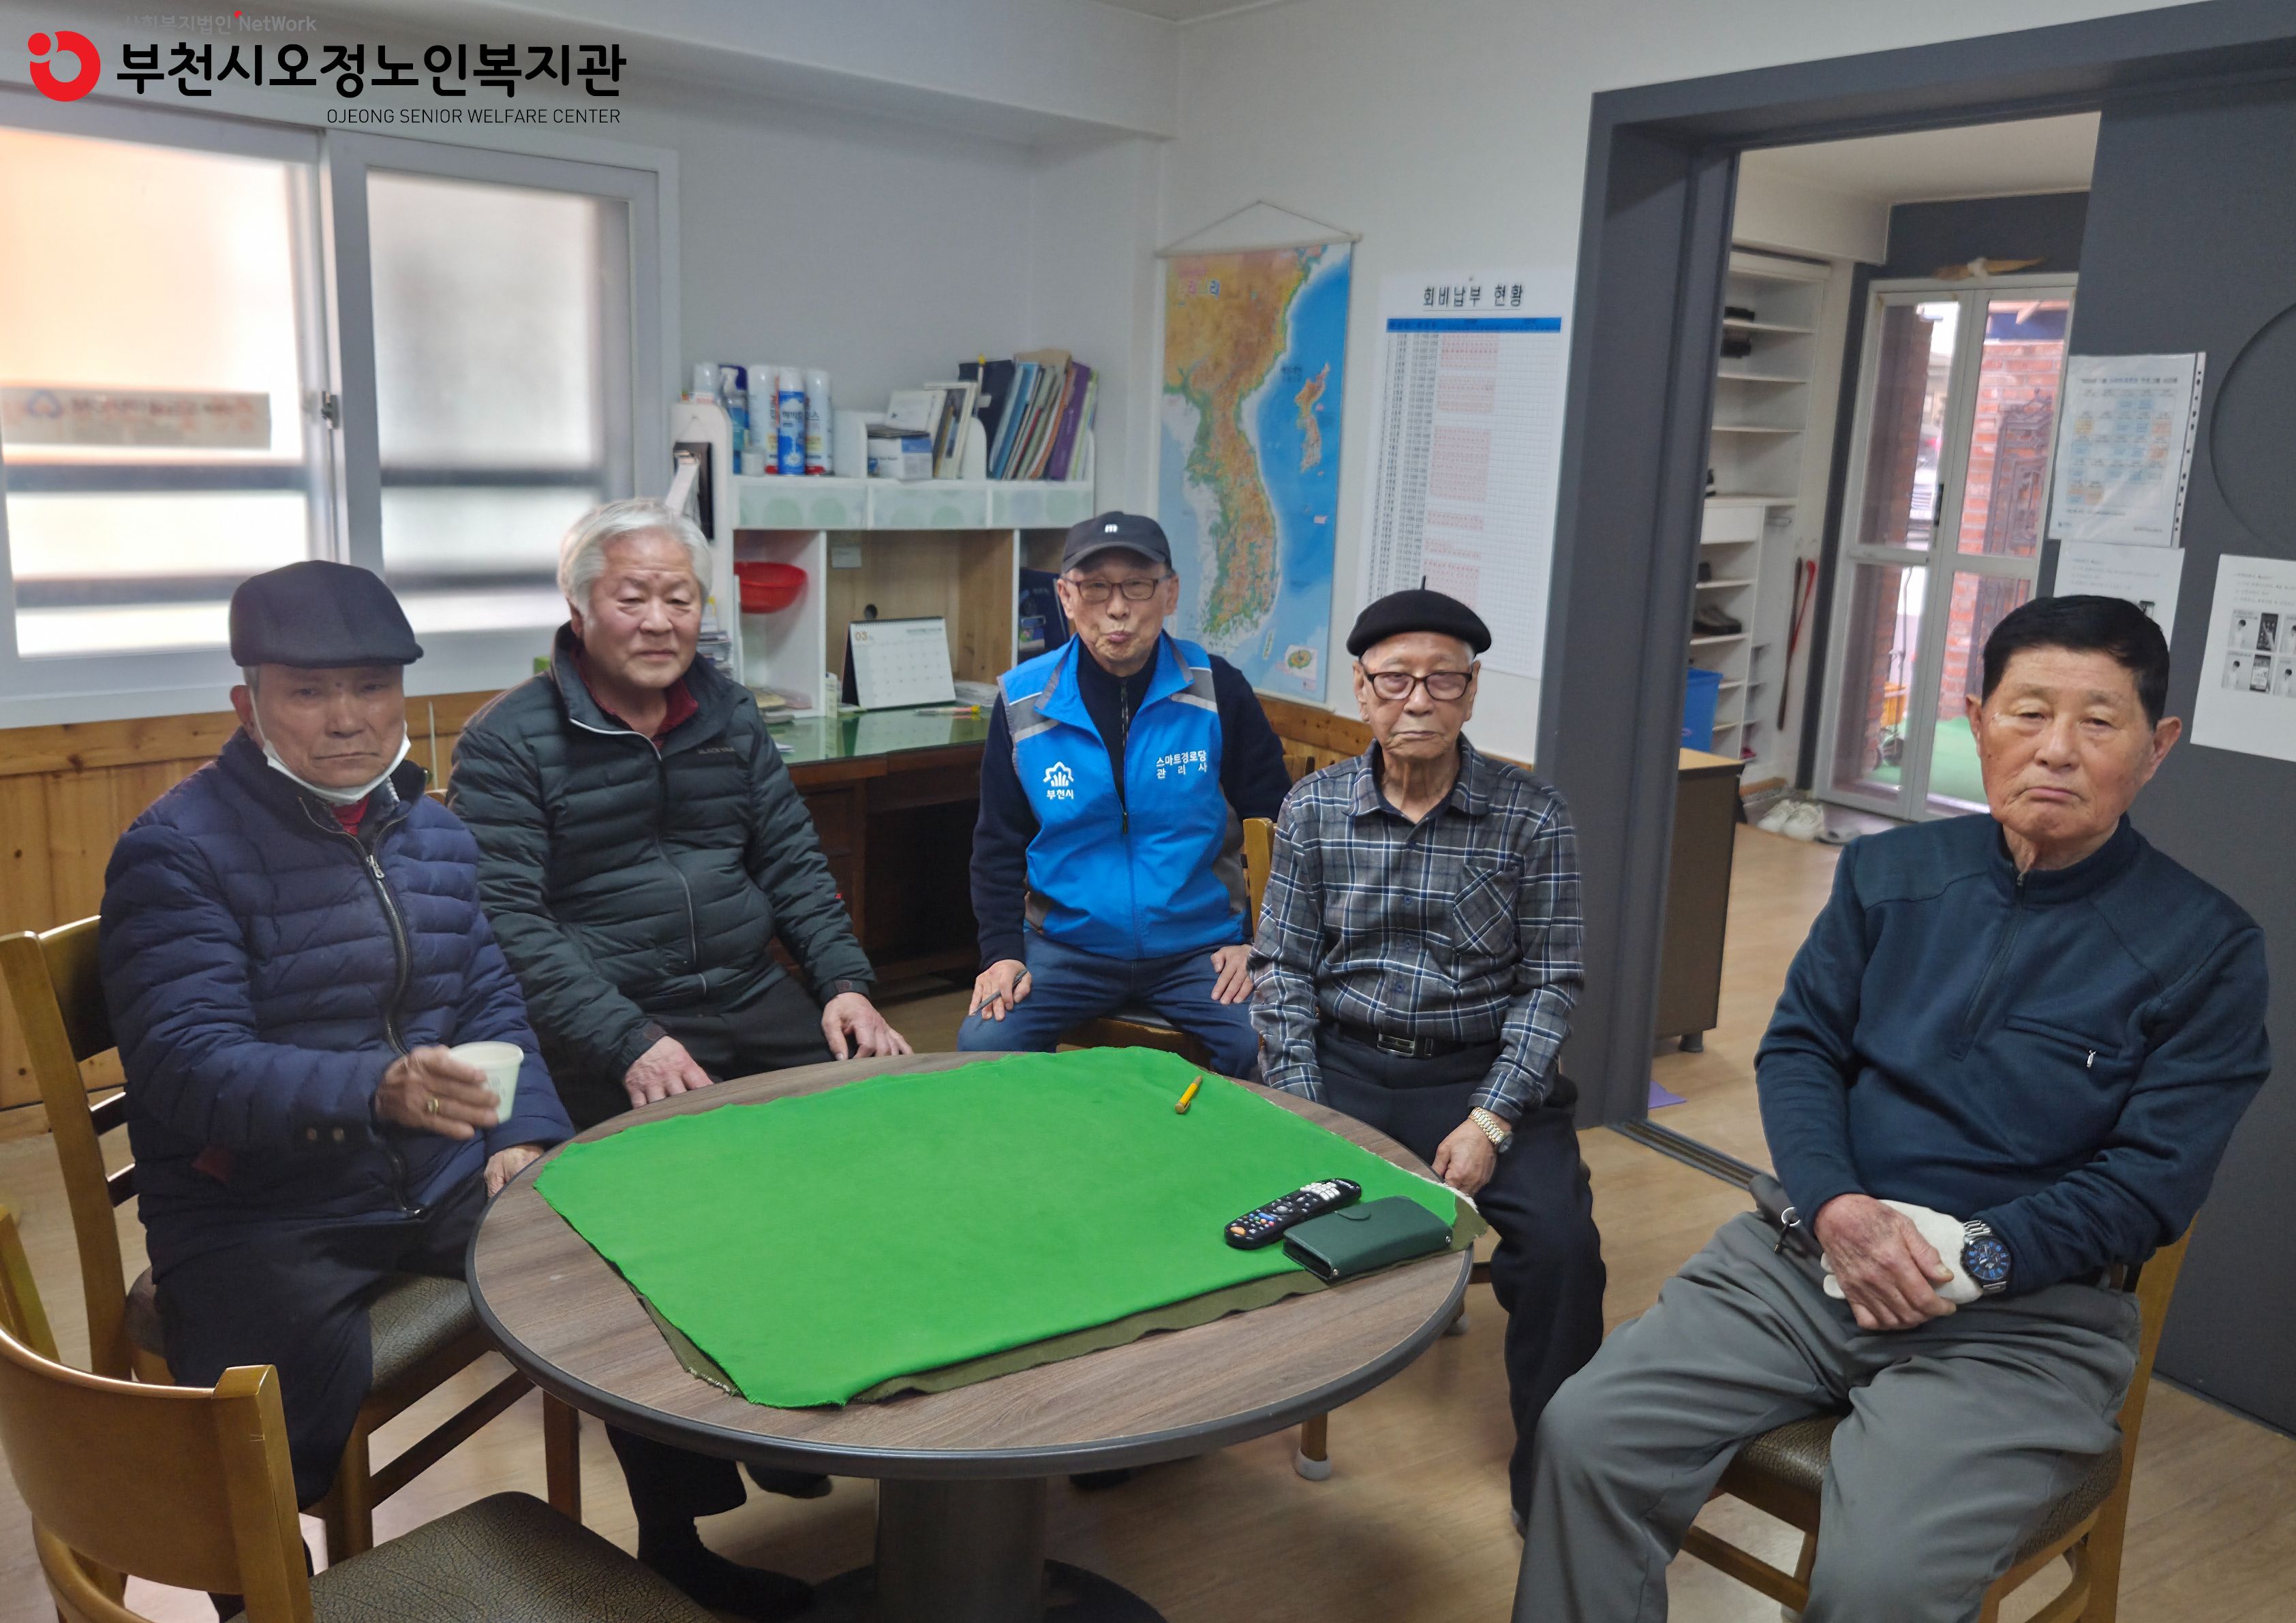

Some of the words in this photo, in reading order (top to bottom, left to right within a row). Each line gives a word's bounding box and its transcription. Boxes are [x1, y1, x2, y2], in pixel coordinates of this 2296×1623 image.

[1423, 286, 1480, 307] 회비납부
[1495, 284, 1522, 307] 현황
[1156, 749, 1207, 767] 스마트경로당
[1046, 789, 1074, 800] 부천시
